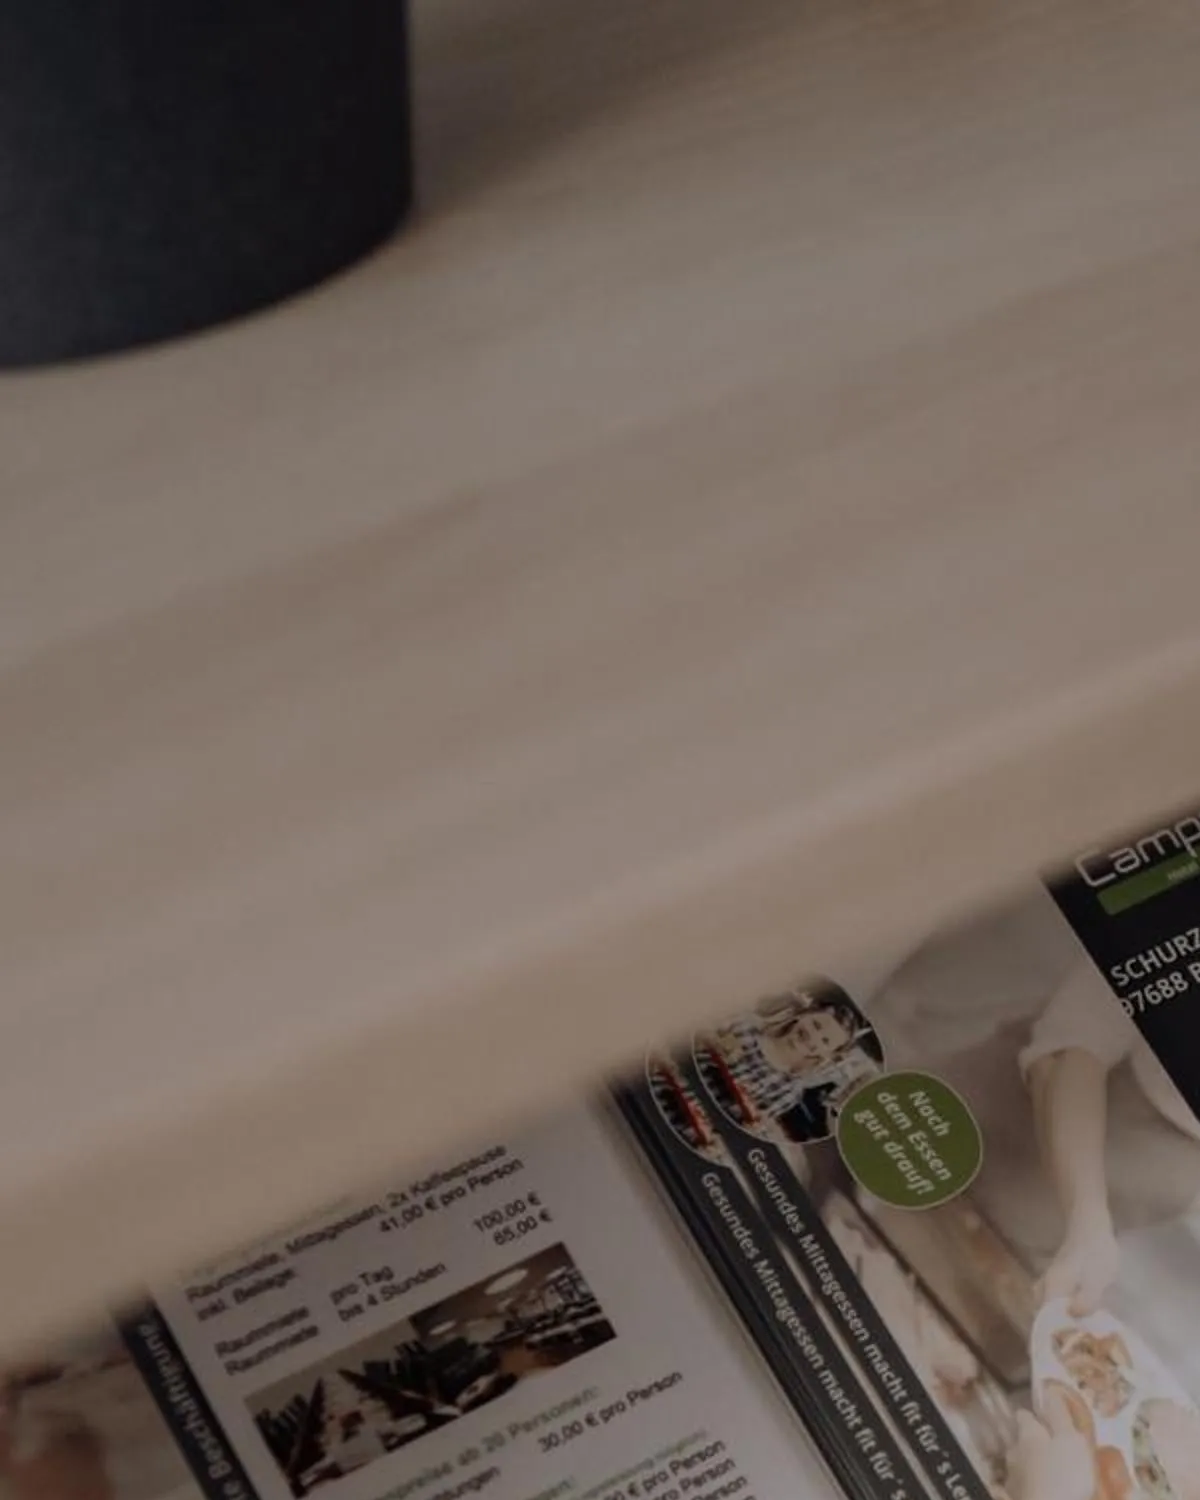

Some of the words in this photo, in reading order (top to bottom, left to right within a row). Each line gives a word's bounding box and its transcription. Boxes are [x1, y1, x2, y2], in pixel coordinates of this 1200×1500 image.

[852, 1106, 890, 1143] gut
[882, 1136, 935, 1198] drauf!
[875, 1089, 913, 1132] dem
[906, 1128, 952, 1183] Essen
[423, 1196, 438, 1212] €
[438, 1186, 468, 1208] pro
[465, 1157, 524, 1192] Person
[328, 1281, 361, 1306] pro
[357, 1263, 395, 1289] Tag
[378, 1261, 448, 1302] Stunden
[698, 1170, 762, 1260] Gesundes
[749, 1257, 828, 1370] Mittagessen
[817, 1367, 863, 1428] macht
[853, 1426, 878, 1452] fit
[744, 1146, 807, 1235] Gesundes
[795, 1232, 873, 1344] Mittagessen
[861, 1341, 908, 1402] macht
[899, 1399, 923, 1424] fit
[536, 1419, 585, 1454] 30,00
[582, 1412, 599, 1428] €
[597, 1399, 628, 1424] pro
[624, 1369, 684, 1407] Person
[640, 1469, 670, 1494] pro
[667, 1438, 726, 1476] Person
[678, 1456, 737, 1493] Person
